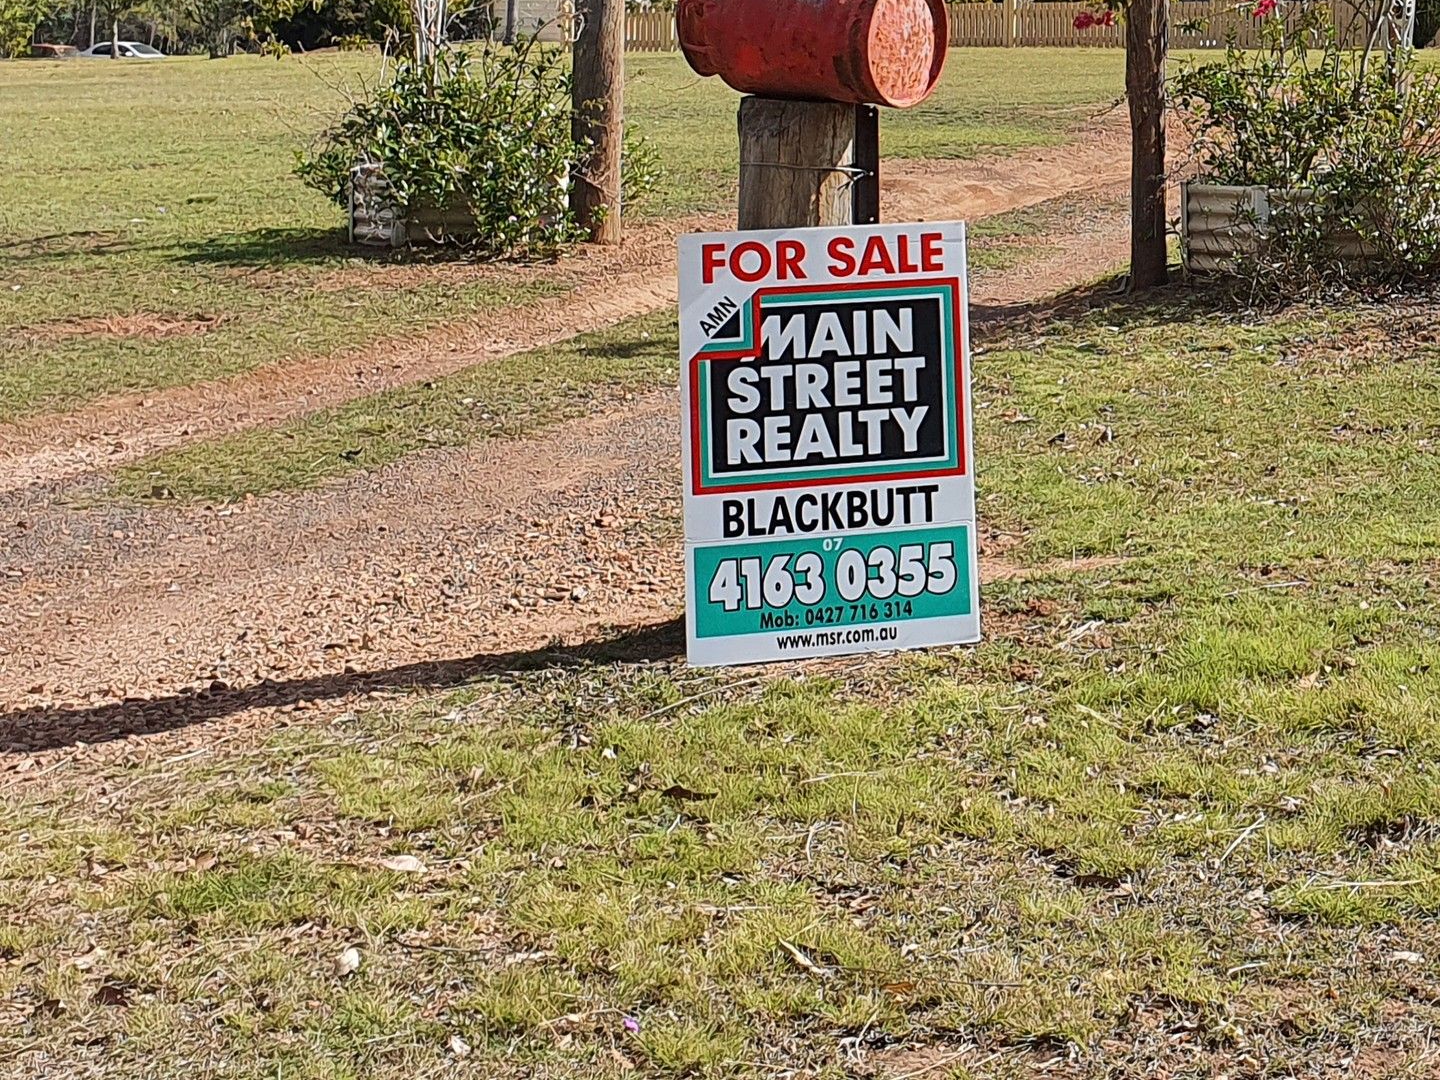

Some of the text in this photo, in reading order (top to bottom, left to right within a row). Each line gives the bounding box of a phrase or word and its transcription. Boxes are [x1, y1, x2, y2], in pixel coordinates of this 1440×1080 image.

[702, 233, 944, 284] FOR SALE
[699, 295, 738, 337] AMN
[761, 308, 913, 361] MAIN
[727, 357, 926, 414] STREET
[726, 406, 930, 465] REALTY
[722, 484, 939, 538] BLACKBUTT
[822, 537, 844, 552] 07
[708, 541, 957, 612] 4163 0355
[760, 601, 913, 630] Mob: 0427 716 314
[776, 626, 898, 650] www.msr.com.au
